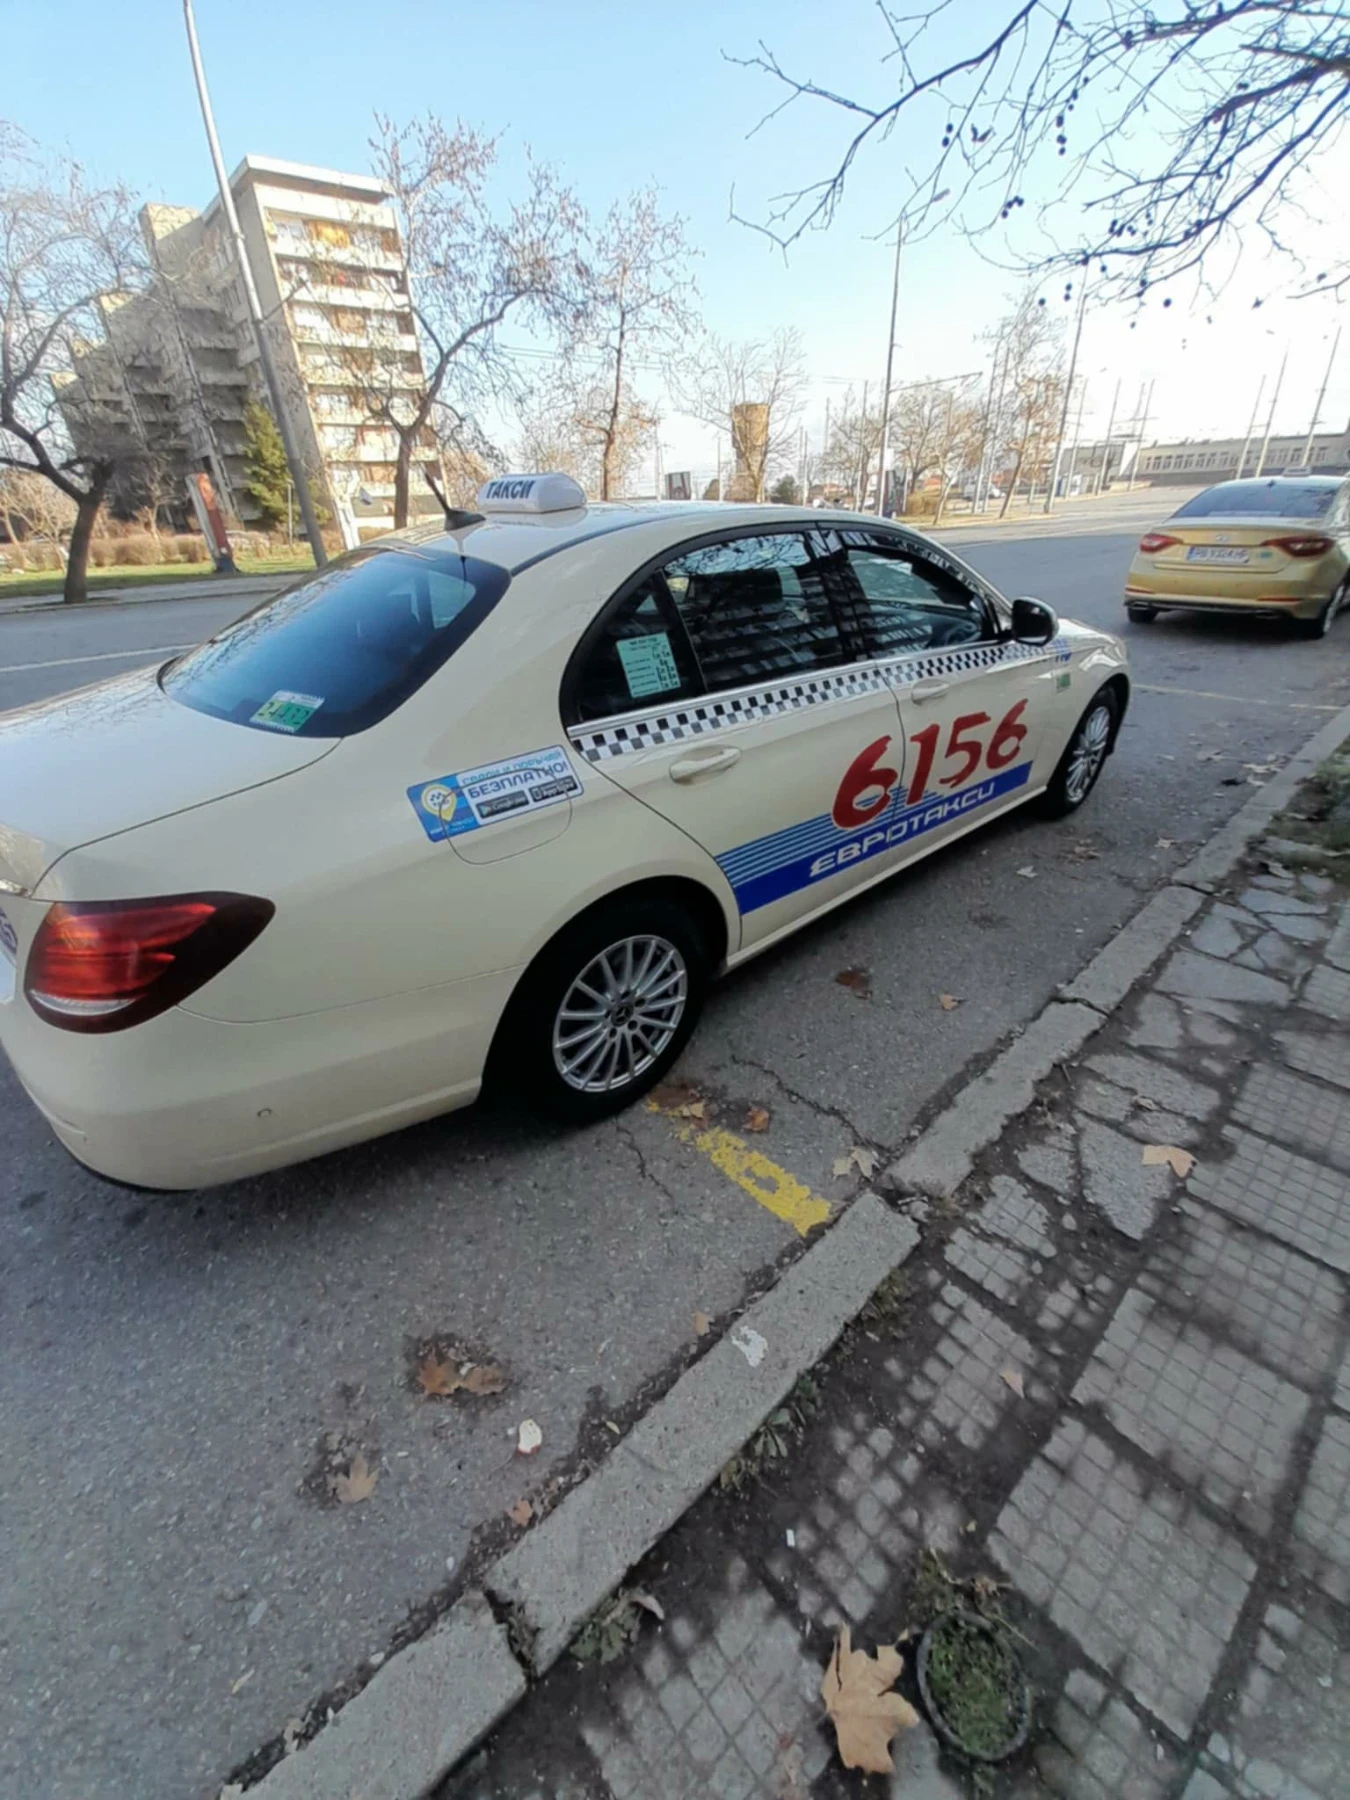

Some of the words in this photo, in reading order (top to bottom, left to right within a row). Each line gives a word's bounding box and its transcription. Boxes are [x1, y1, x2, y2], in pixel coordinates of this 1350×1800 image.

[485, 480, 536, 499] ТАКСИ
[467, 761, 569, 799] БЕЗПЛАТНО!
[831, 697, 1029, 830] 6156
[809, 782, 996, 878] ЕВРОТАКСИ
